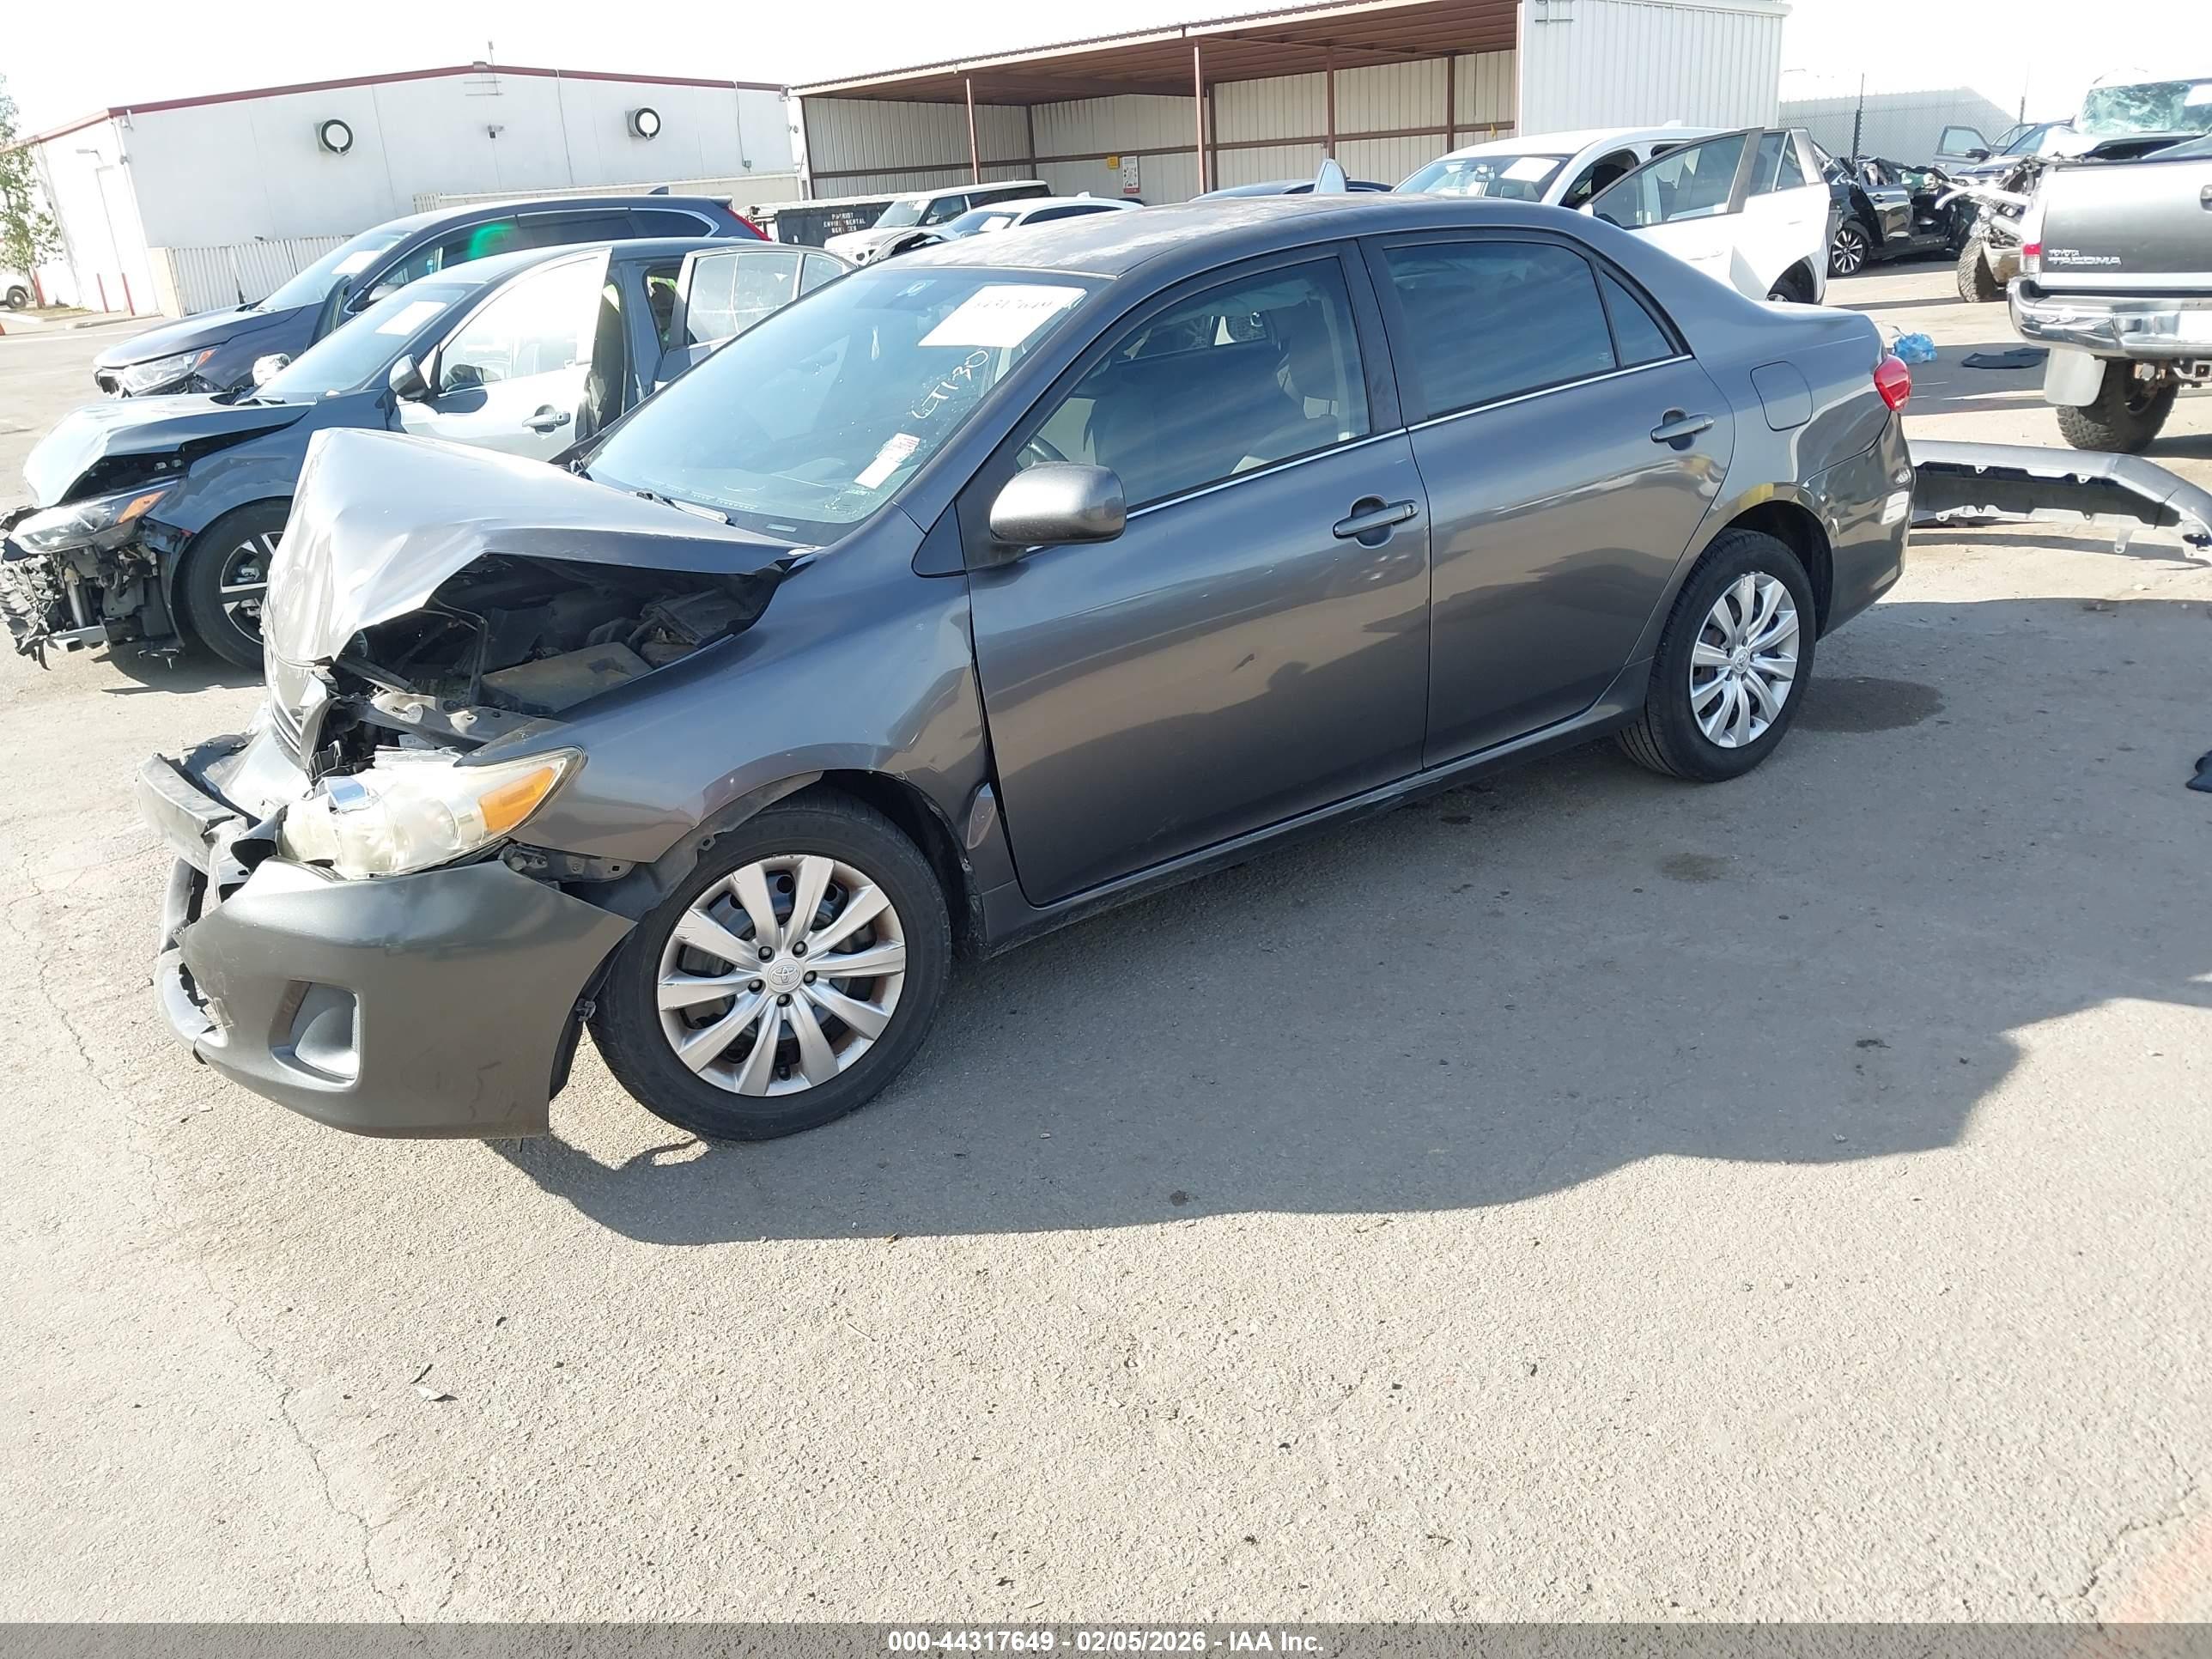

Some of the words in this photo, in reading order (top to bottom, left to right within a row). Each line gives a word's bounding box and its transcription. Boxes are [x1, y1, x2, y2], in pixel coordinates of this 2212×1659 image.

[831, 212, 854, 221] PATRIOT
[823, 217, 866, 228] ENVIRMENTAL
[831, 225, 857, 234] SERVCES
[2048, 248, 2080, 258] TOYOTA
